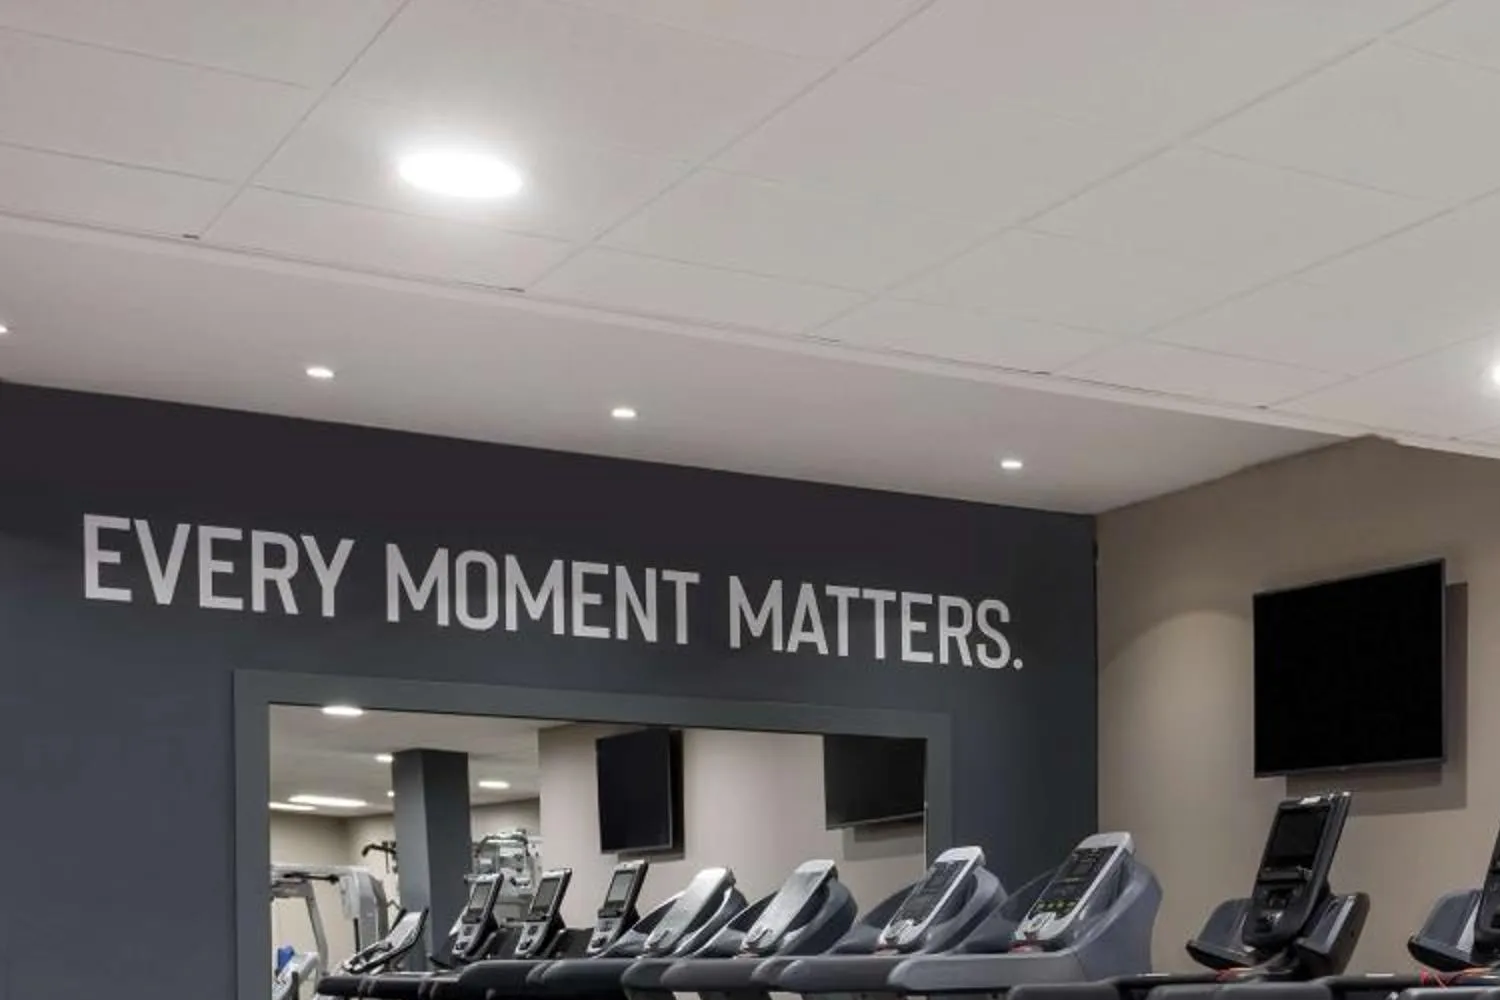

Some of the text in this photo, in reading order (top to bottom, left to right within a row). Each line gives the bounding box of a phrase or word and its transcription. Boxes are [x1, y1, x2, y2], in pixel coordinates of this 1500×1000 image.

[83, 513, 1024, 671] EVERY MOMENT MATTERS.
